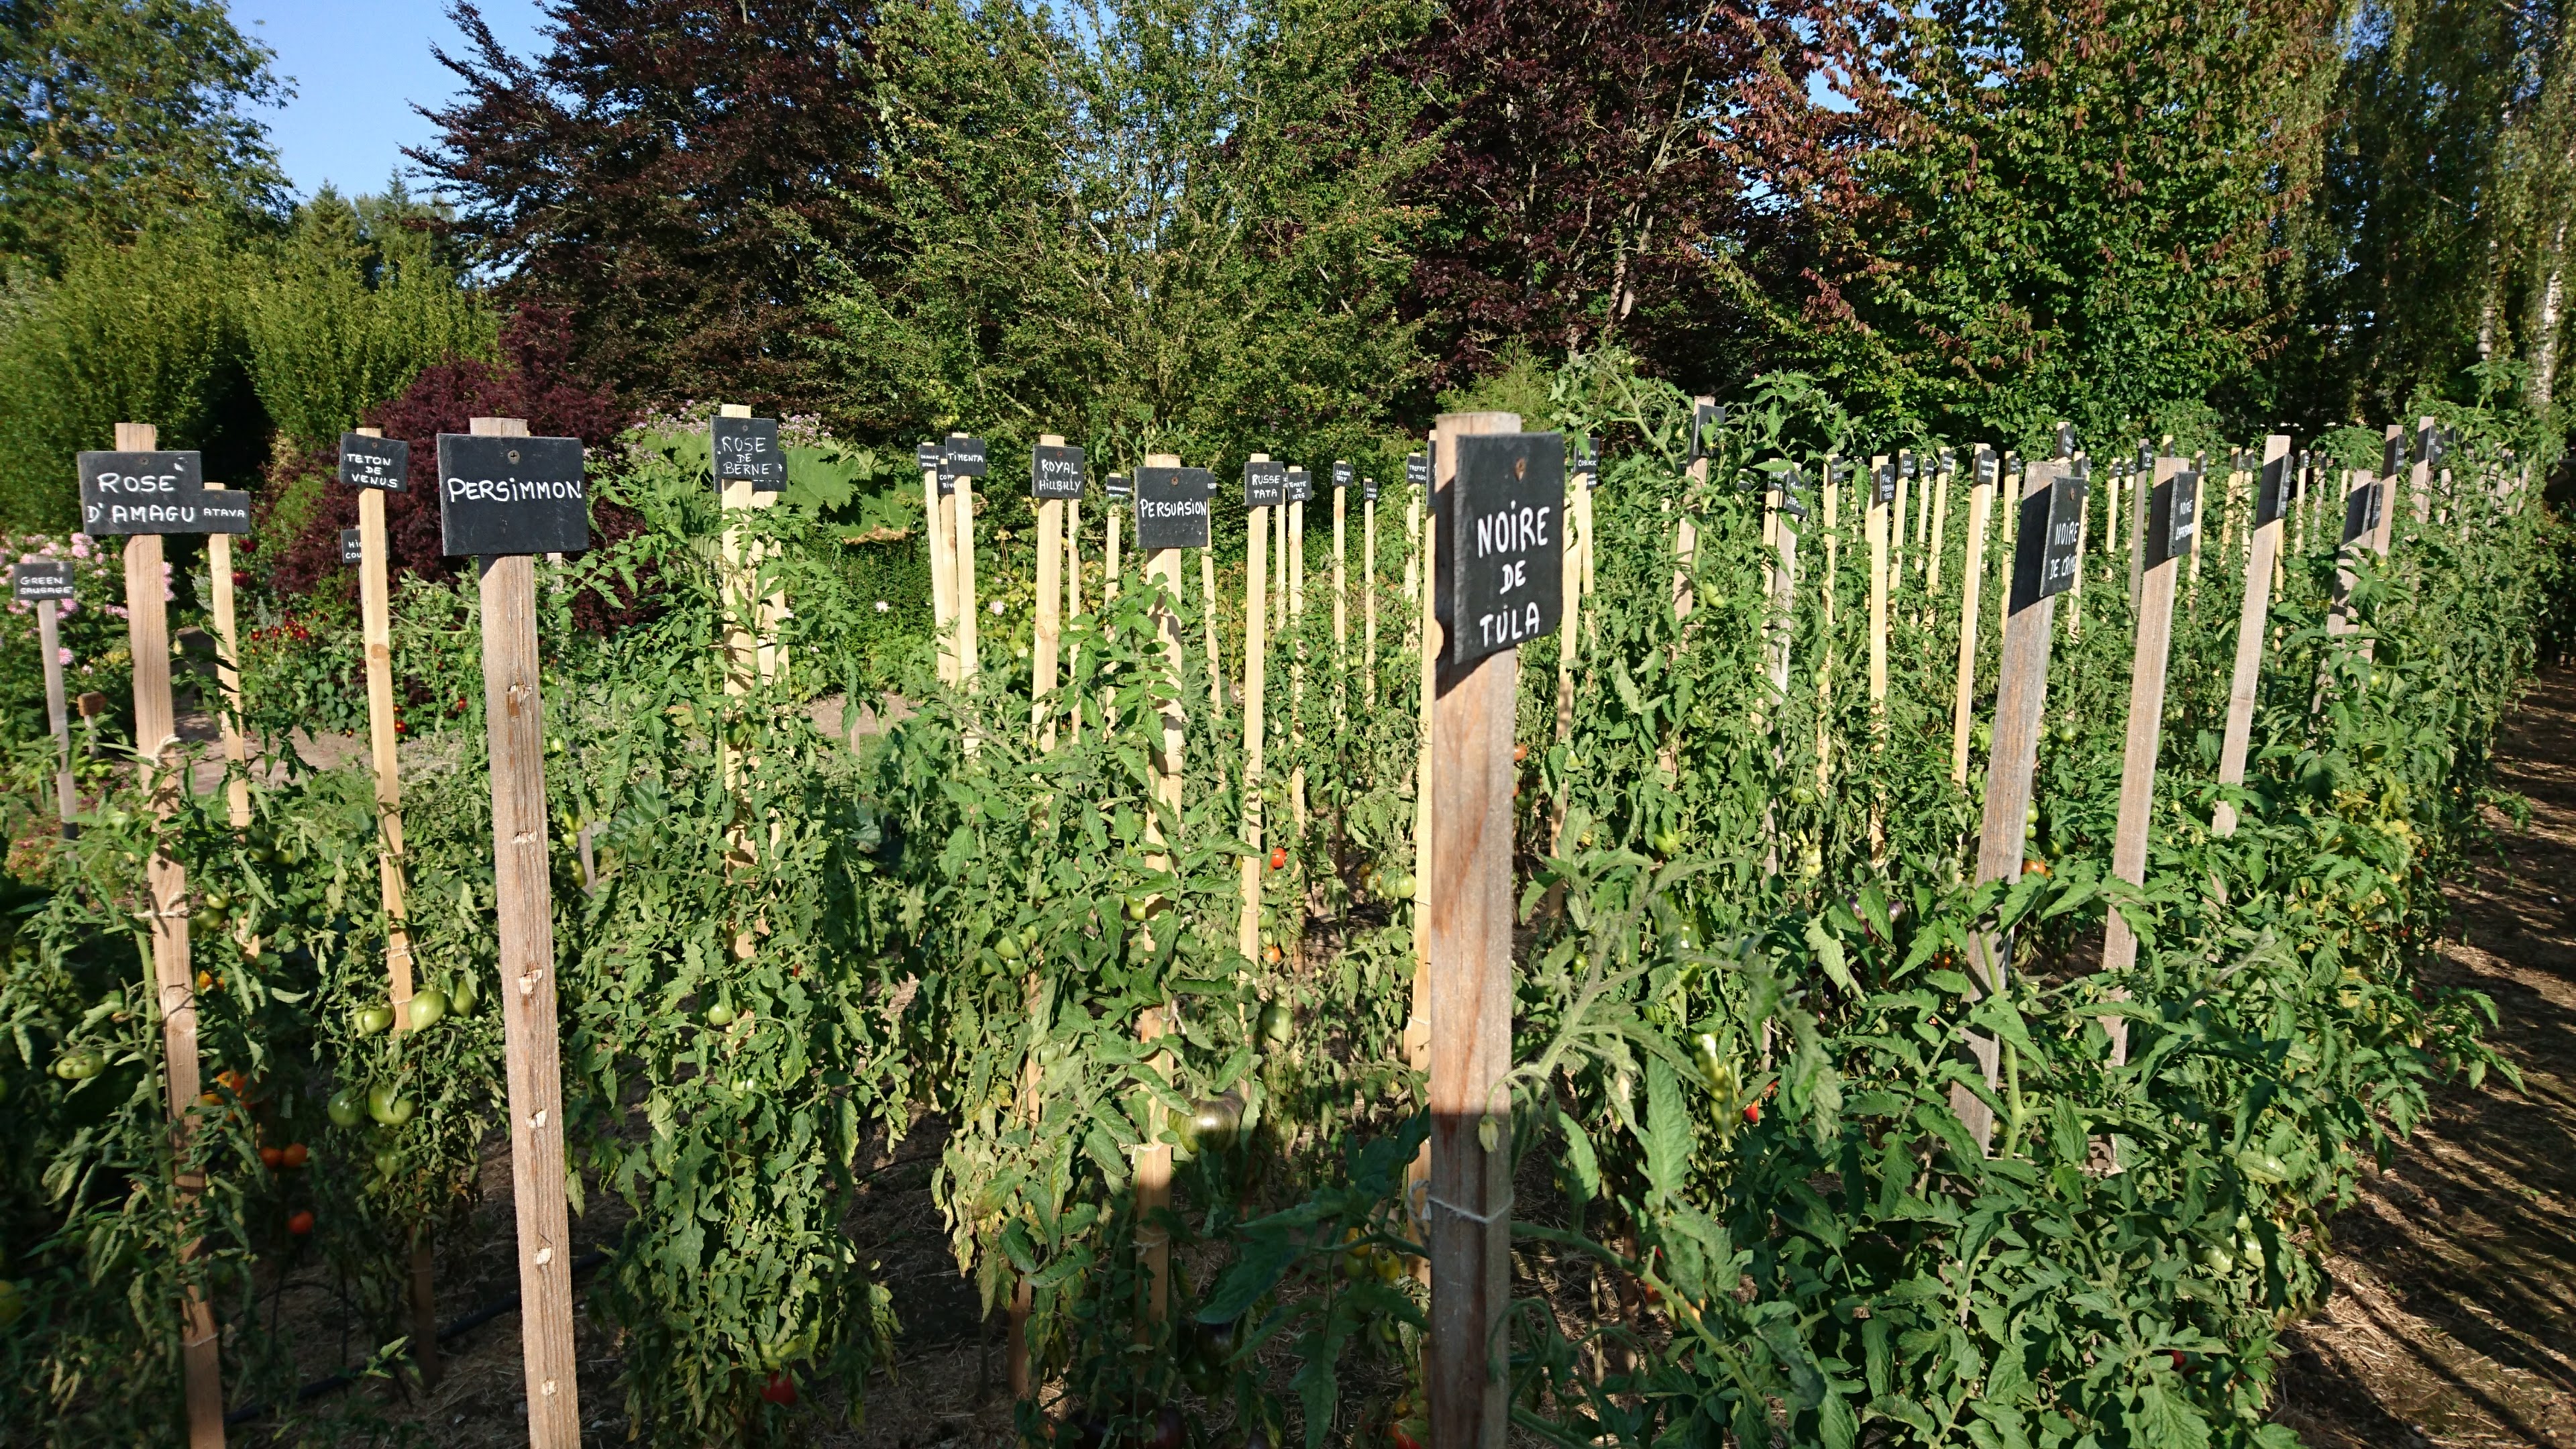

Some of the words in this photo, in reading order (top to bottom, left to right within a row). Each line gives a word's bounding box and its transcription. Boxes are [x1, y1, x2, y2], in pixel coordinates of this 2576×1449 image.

[722, 436, 766, 453] ROSE
[347, 453, 391, 466] TETON
[736, 453, 753, 464] DE
[365, 466, 383, 475] DE
[722, 462, 772, 476] BERNE
[1041, 459, 1079, 475] ROYAL
[97, 472, 177, 494] ROSE
[352, 473, 398, 488] VENUS
[1252, 473, 1281, 486] RUSSE
[1336, 475, 1348, 484] BOY
[1254, 488, 1278, 499] TATA
[203, 507, 246, 519] ATAVA
[2049, 558, 2060, 580] DE
[20, 576, 64, 586] GREEN
[1499, 559, 1526, 595] DE
[19, 586, 74, 595] SAUSAGE
